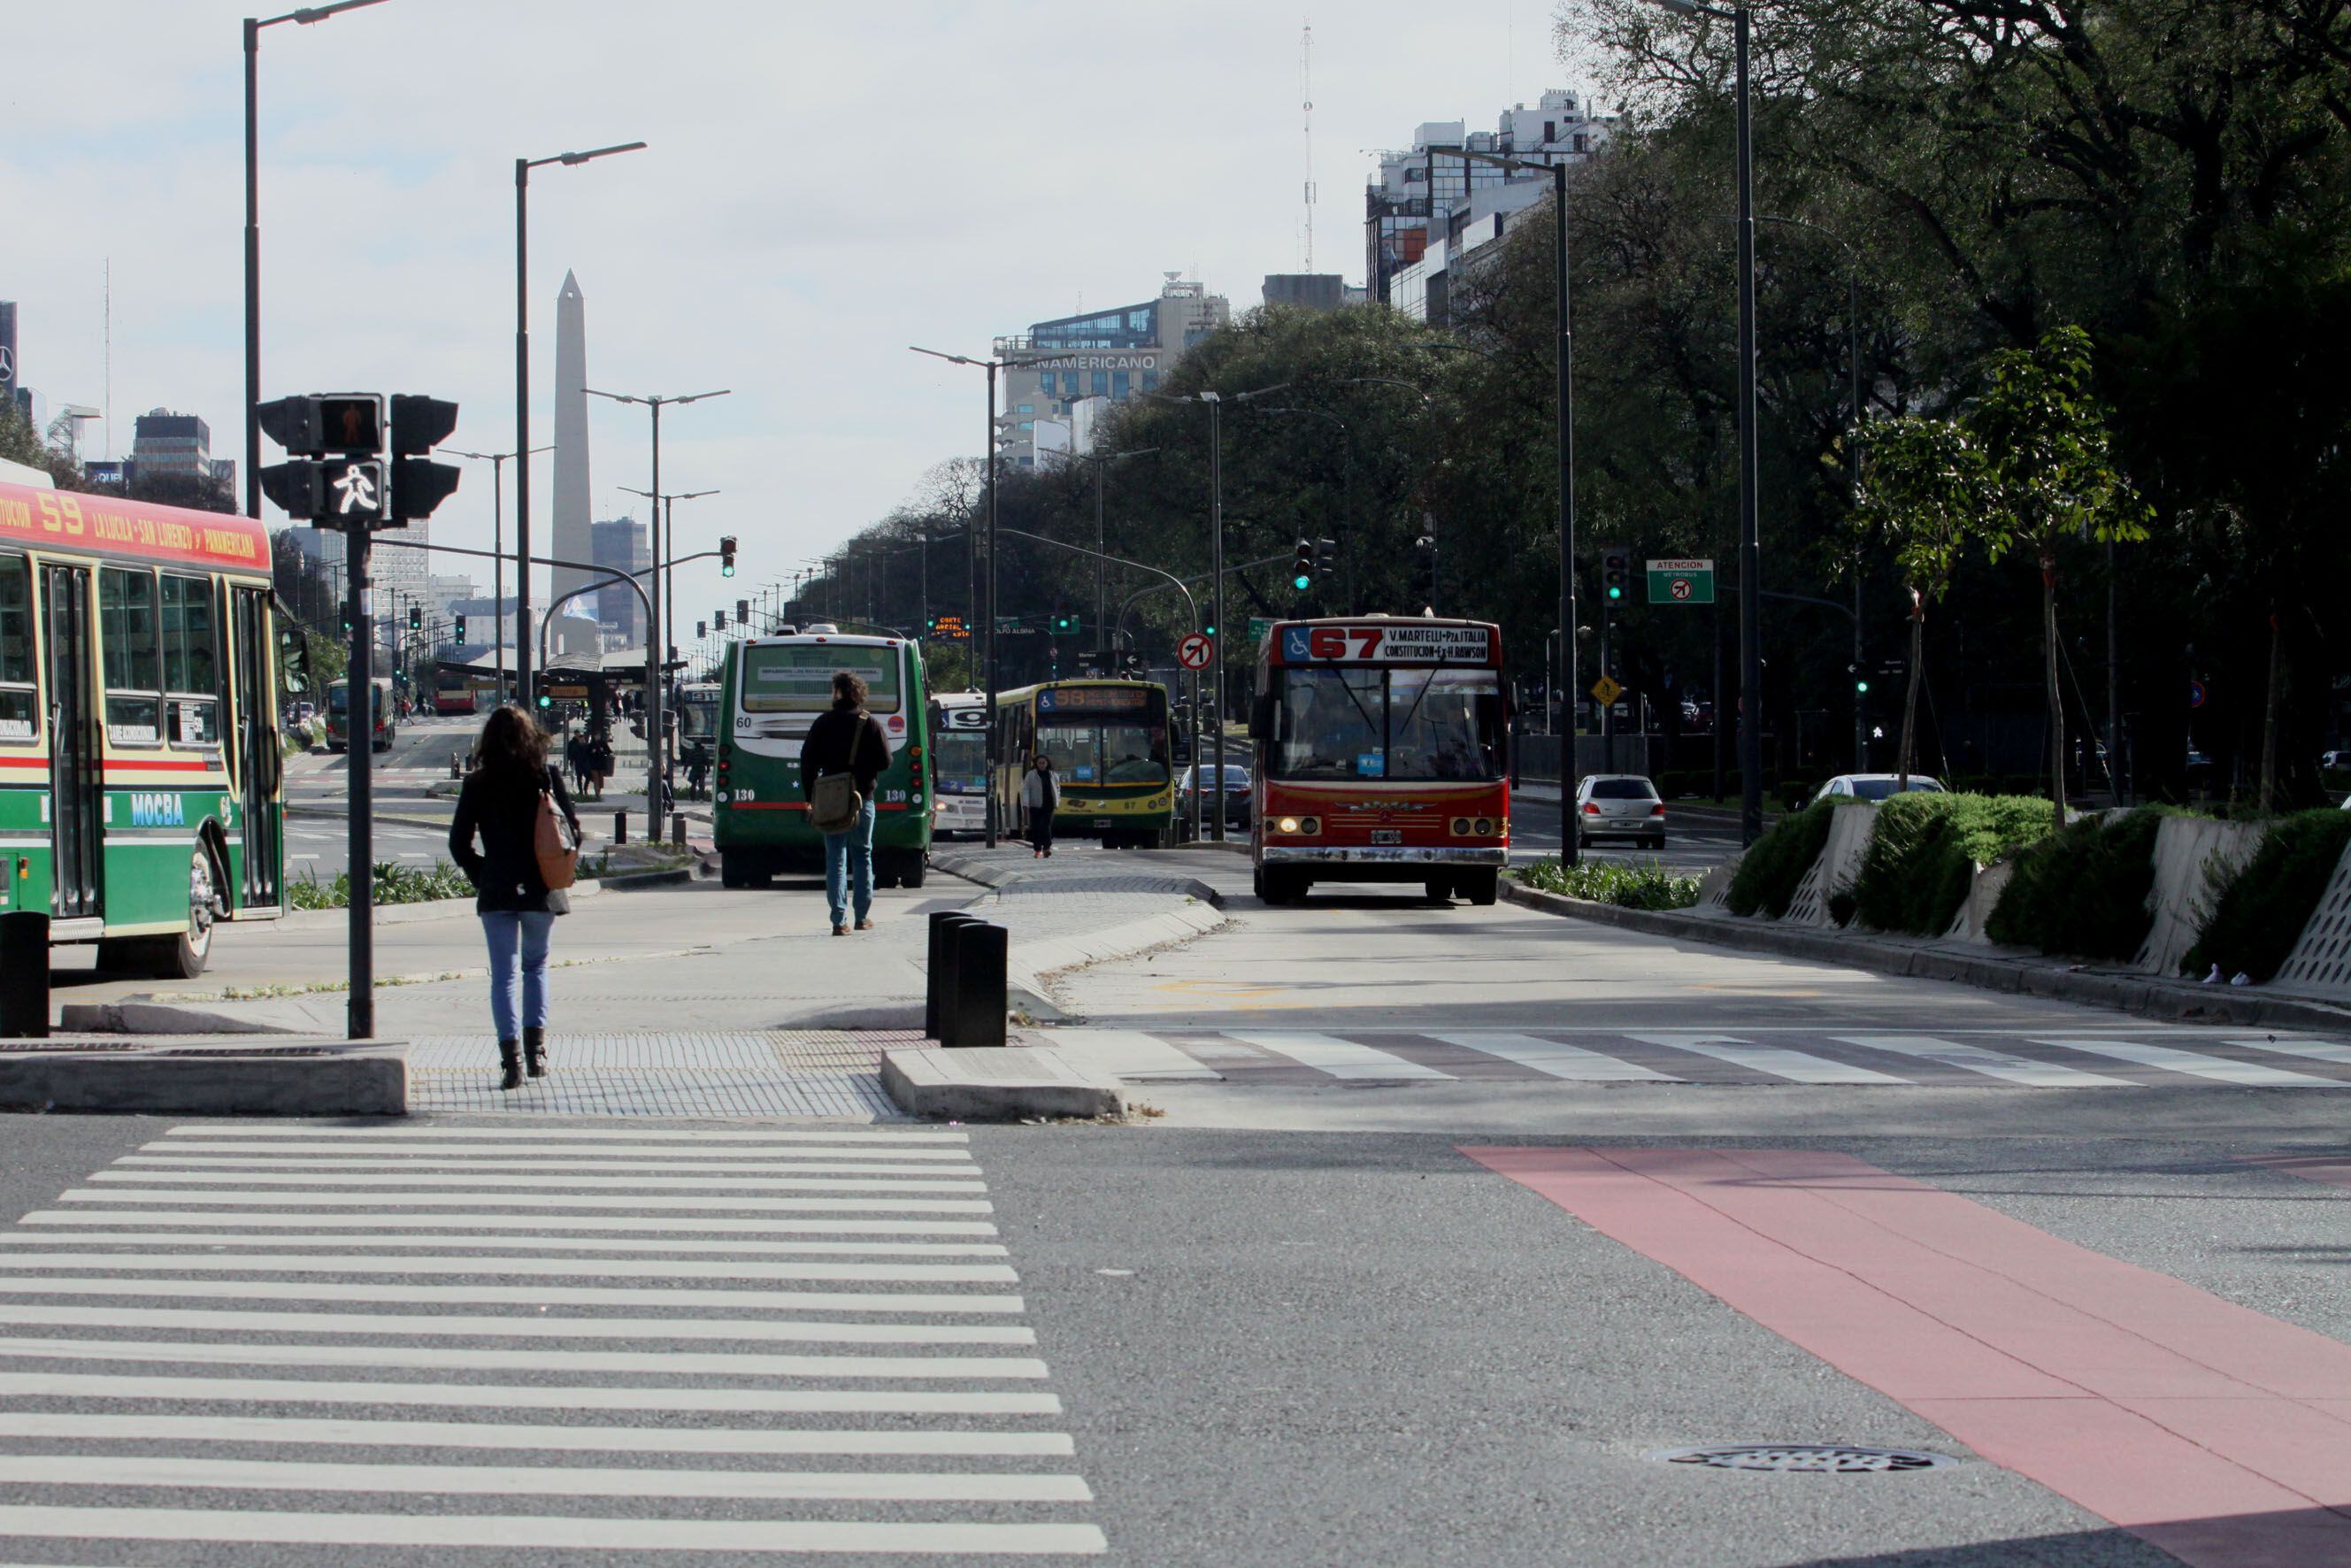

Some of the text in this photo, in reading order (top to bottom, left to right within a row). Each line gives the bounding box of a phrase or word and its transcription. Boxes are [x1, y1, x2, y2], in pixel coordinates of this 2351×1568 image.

[0, 497, 32, 529] TUCION
[35, 491, 85, 534] 59
[138, 519, 157, 545] SAN
[158, 522, 193, 550] LORENZO
[204, 527, 256, 559] PANAMERICANA
[1310, 628, 1384, 658] 67
[1054, 689, 1085, 706] 98
[736, 717, 751, 728] 60
[734, 788, 755, 801] 130
[885, 789, 906, 802] 130
[132, 794, 184, 826] MOCBA
